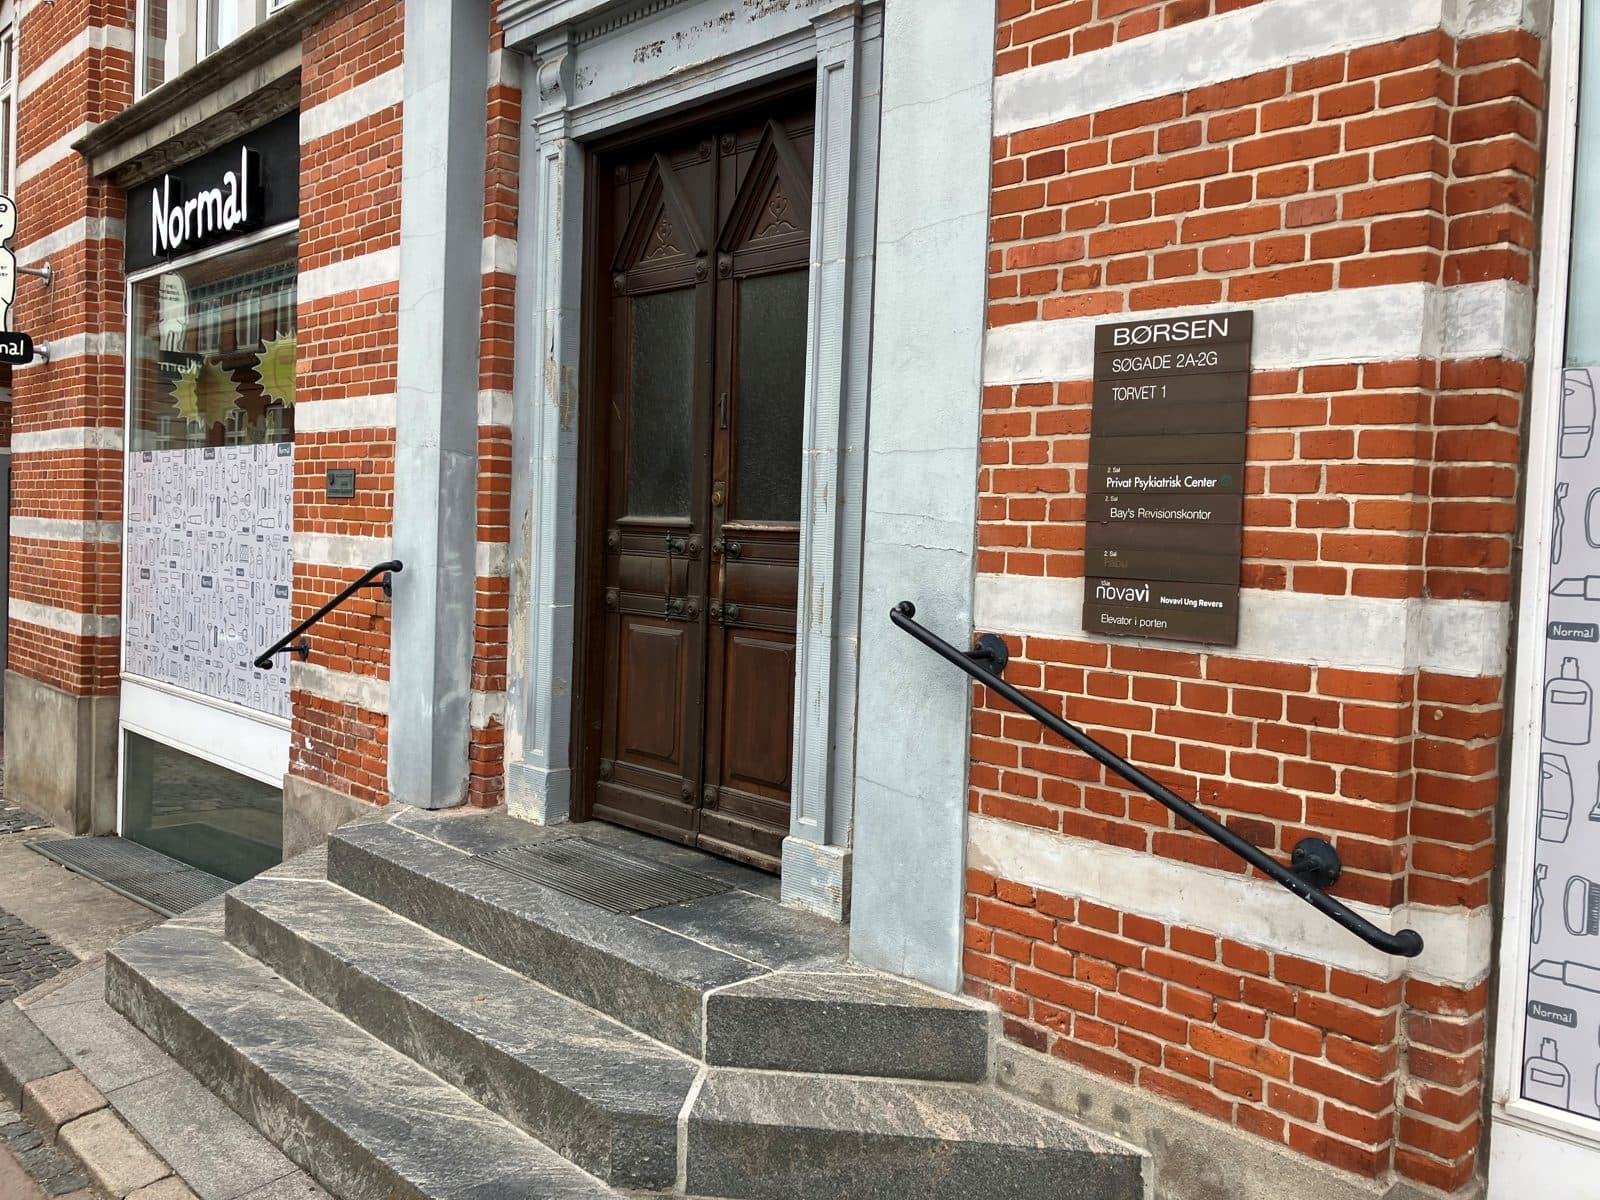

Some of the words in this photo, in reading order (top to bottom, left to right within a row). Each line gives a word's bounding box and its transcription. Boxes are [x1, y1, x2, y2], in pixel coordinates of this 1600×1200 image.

[152, 145, 248, 257] Normal
[1113, 318, 1229, 346] BØRSEN
[1112, 354, 1172, 373] SØGADE
[1176, 351, 1218, 368] 2A-2G
[1112, 385, 1157, 401] TORVET
[1161, 385, 1166, 398] 1
[1106, 477, 1132, 488] Privat
[1134, 475, 1181, 491] Psykiatrisk
[1184, 476, 1217, 488] Center
[1110, 507, 1135, 521] Bay's
[1138, 508, 1212, 520] Revisionskontor
[1160, 596, 1183, 605] Novavi
[1183, 598, 1197, 608] Ung
[1101, 613, 1131, 626] Elevator
[1139, 617, 1167, 629] porten
[1553, 624, 1594, 638] Normal
[1532, 1004, 1573, 1023] Normal
